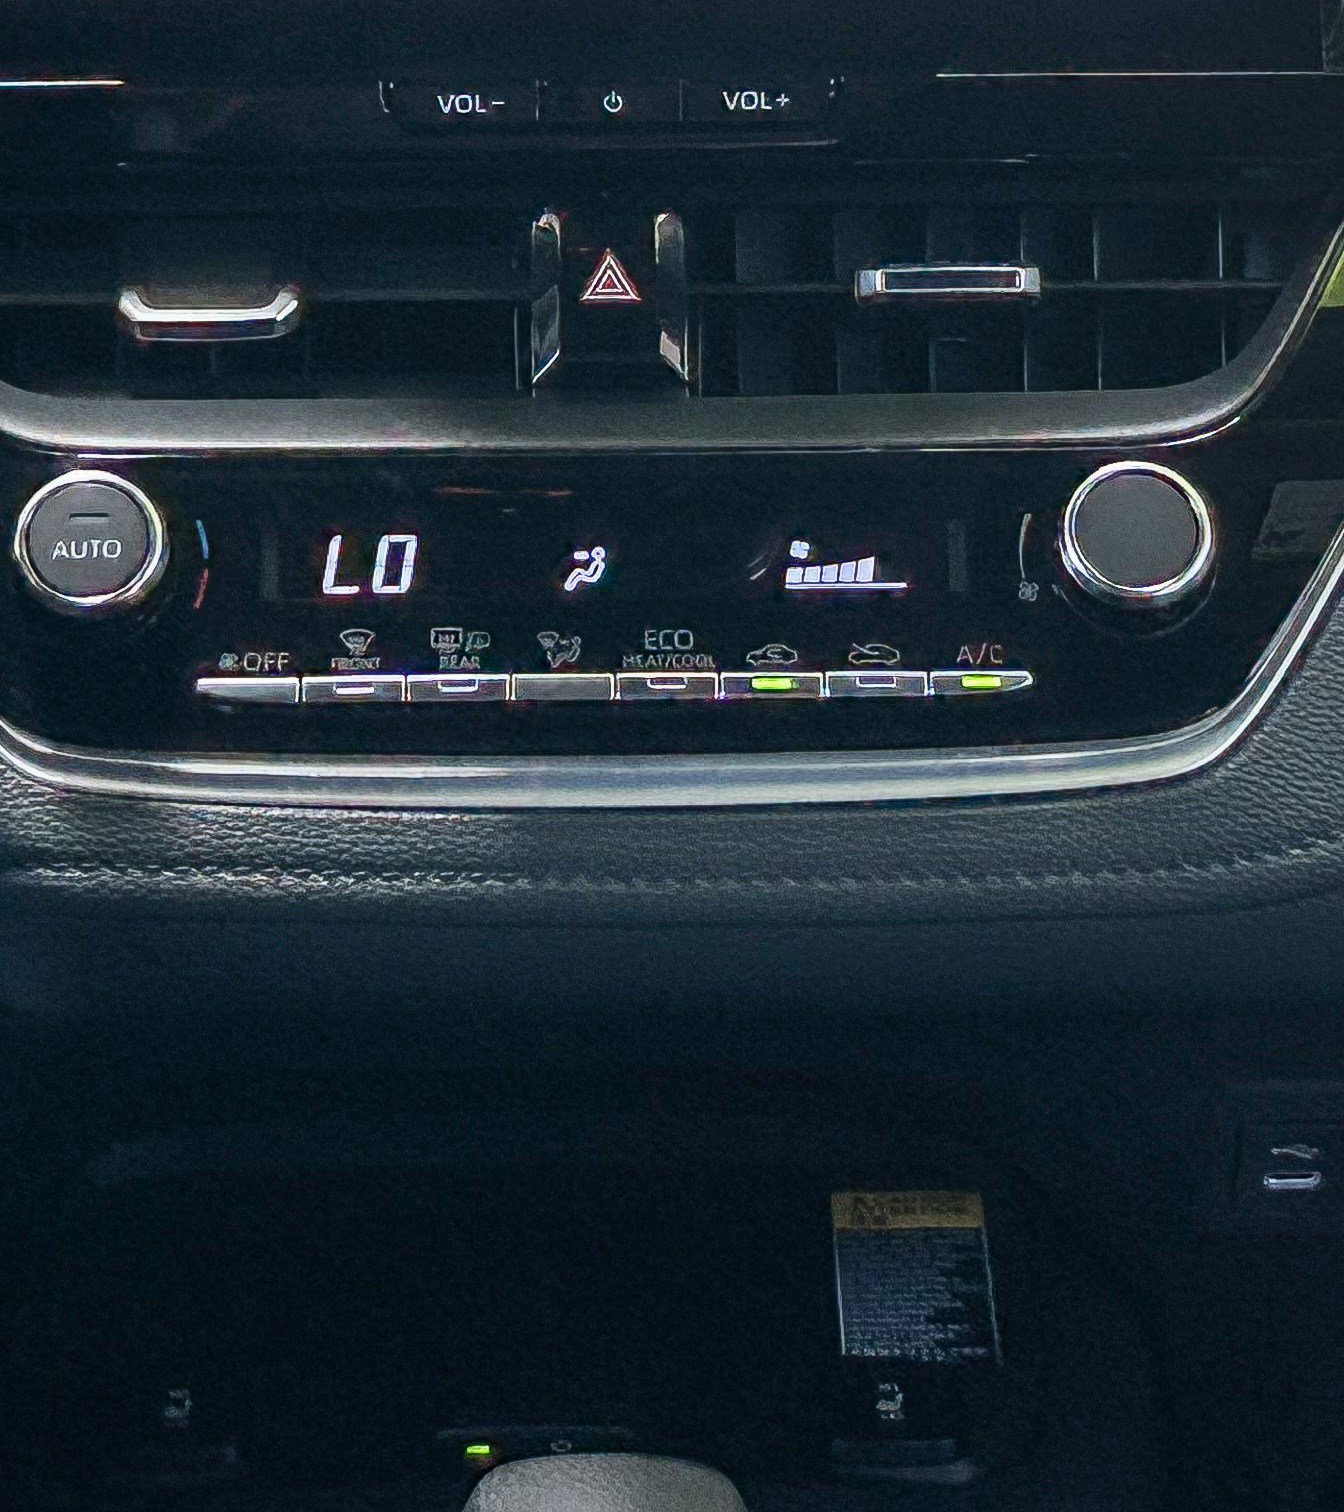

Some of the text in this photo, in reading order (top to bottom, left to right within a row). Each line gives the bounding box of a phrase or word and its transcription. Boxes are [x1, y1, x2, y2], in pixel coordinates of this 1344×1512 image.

[52, 539, 123, 560] AUTO
[323, 534, 418, 595] LO
[644, 629, 694, 650] ECO
[243, 652, 290, 672] OFF
[956, 642, 1003, 665] A/C
